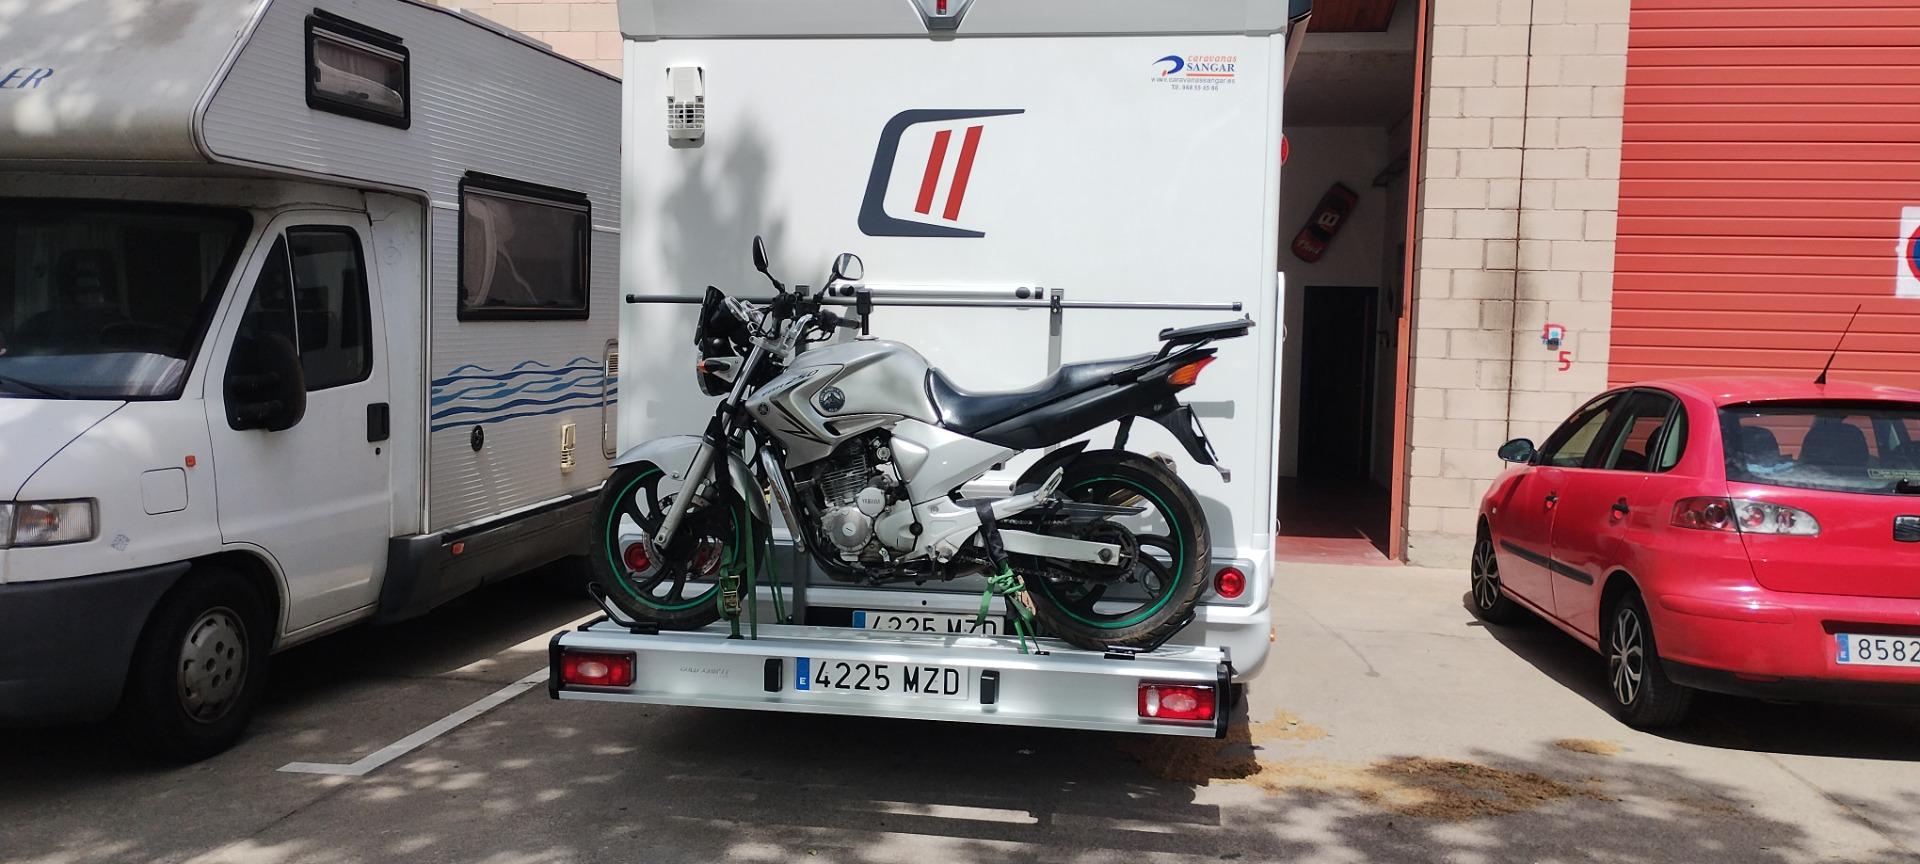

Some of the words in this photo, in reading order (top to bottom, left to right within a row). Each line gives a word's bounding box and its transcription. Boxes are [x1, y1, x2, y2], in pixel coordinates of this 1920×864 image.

[1187, 63, 1235, 72] SANGAR
[1188, 55, 1237, 63] caravanas
[1558, 350, 1572, 372] 5
[1858, 638, 1920, 663] 8582
[800, 677, 807, 685] E
[815, 661, 890, 691] 4225
[903, 665, 959, 696] MZD
